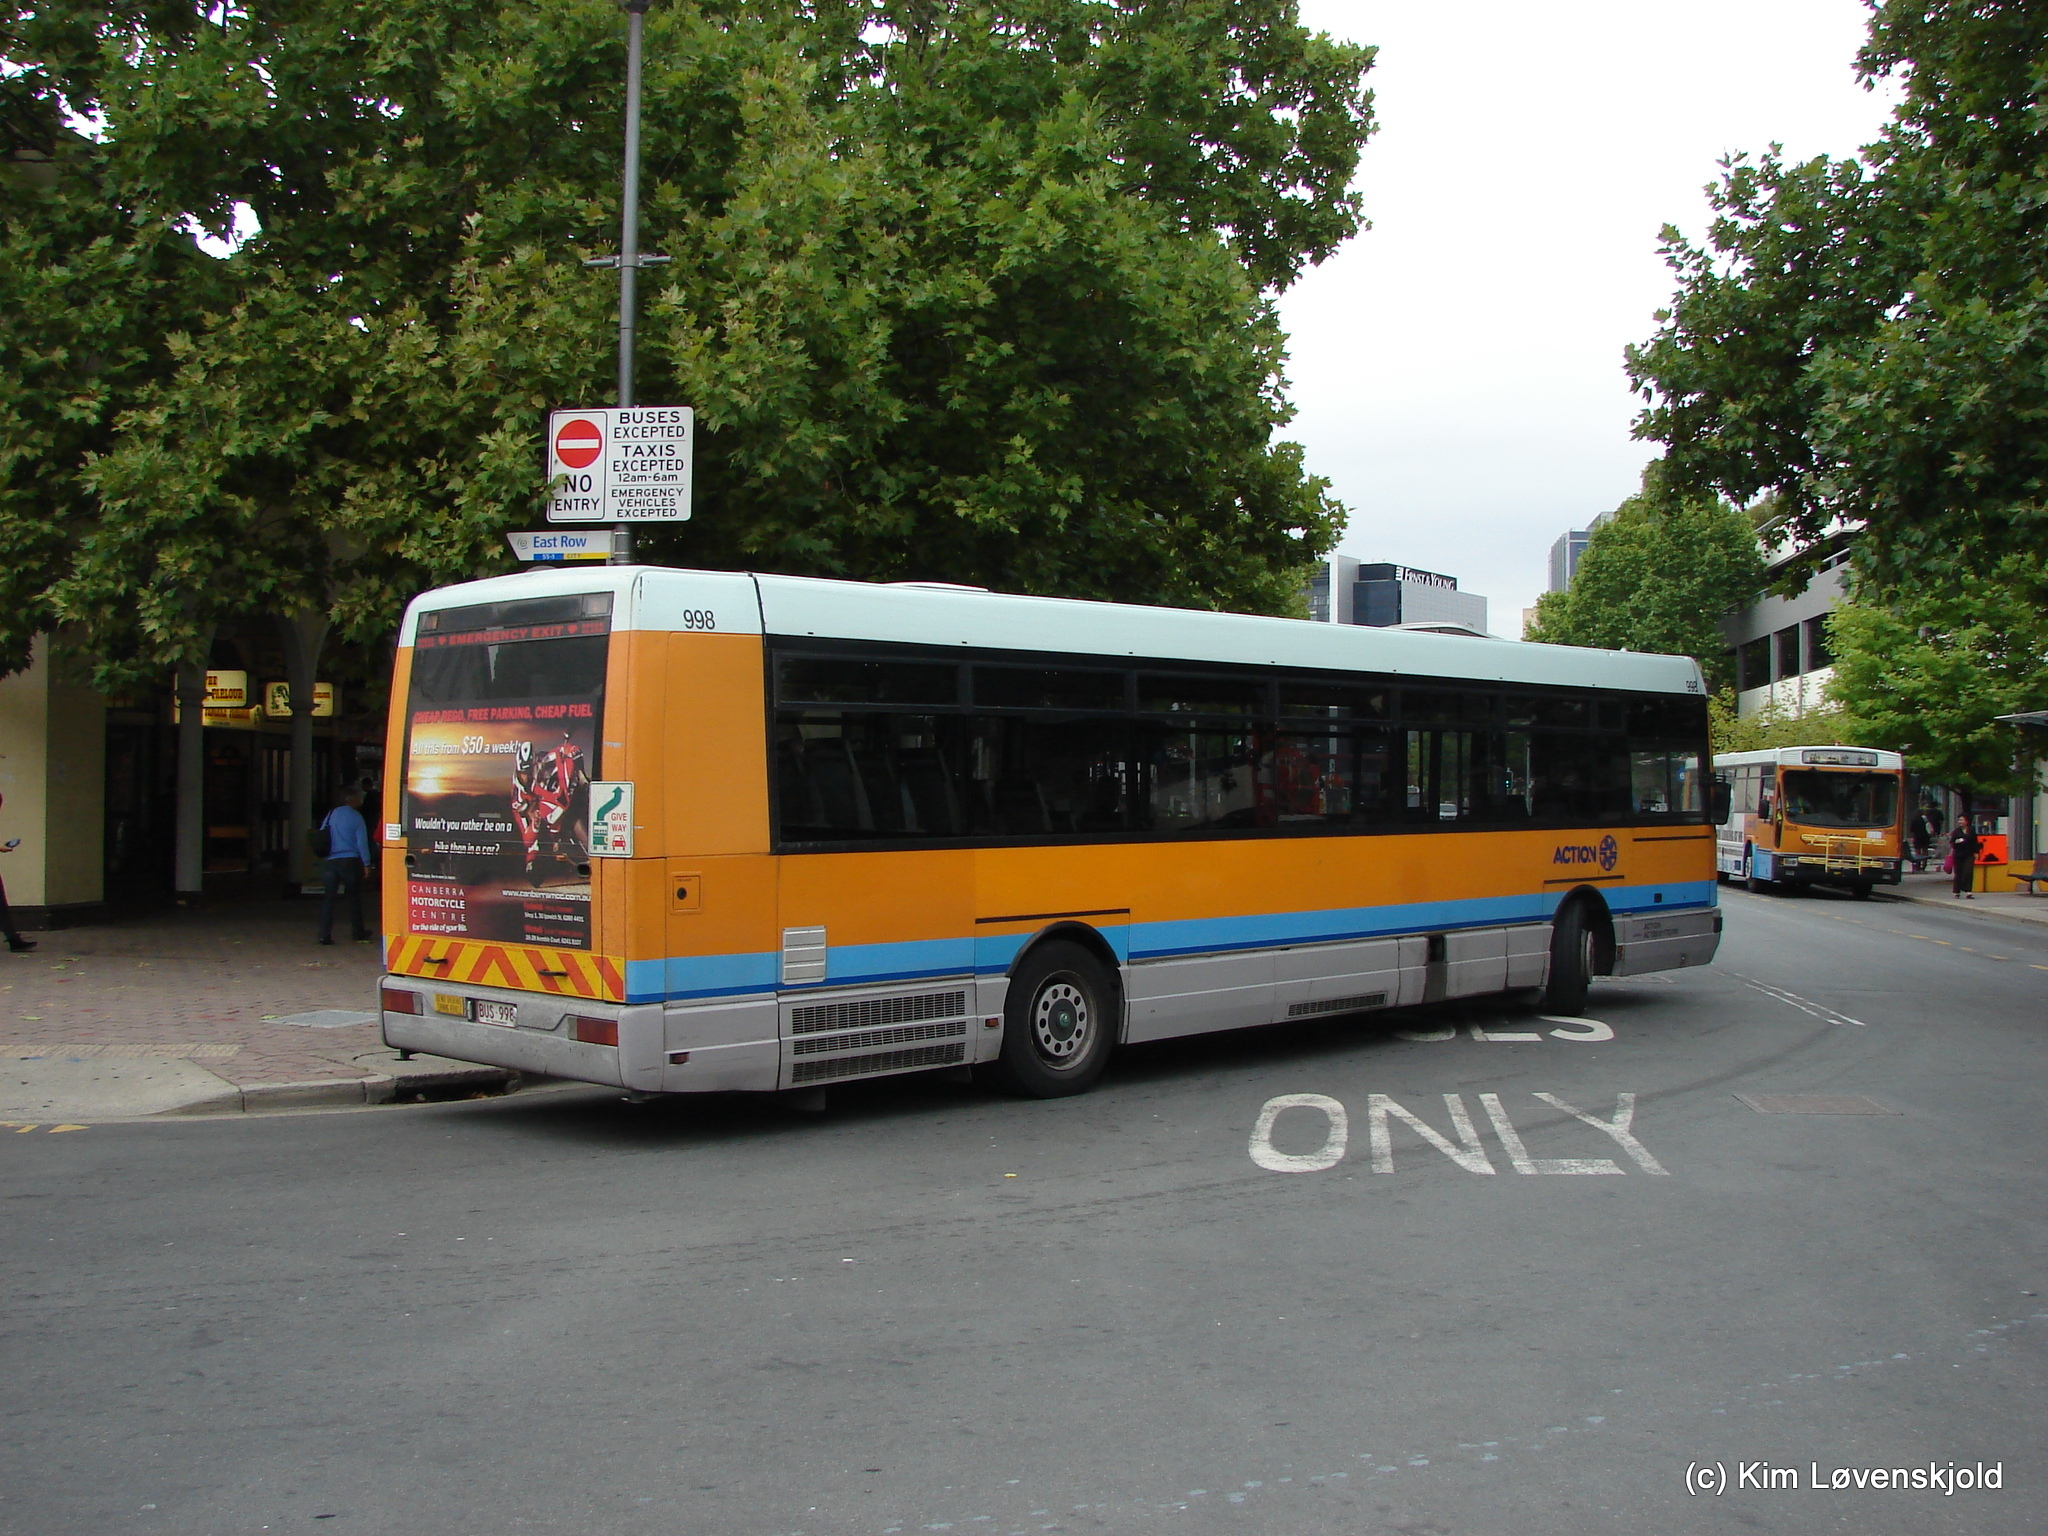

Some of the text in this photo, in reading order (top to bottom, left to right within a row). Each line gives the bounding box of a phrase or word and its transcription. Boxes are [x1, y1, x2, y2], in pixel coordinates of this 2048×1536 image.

[619, 411, 680, 424] BUSES
[614, 426, 685, 438] EXCEPTED
[622, 445, 676, 457] TAXIS
[612, 460, 684, 472] EXCEPTED
[564, 474, 592, 493] NO
[618, 473, 678, 482] 12am-6am
[611, 488, 684, 498] EMERGENCY
[555, 498, 600, 511] ENTRY
[619, 498, 676, 507] VEHICLES
[617, 509, 677, 518] EXCEPTED
[533, 535, 587, 548] East Row
[683, 609, 716, 630] 998
[450, 627, 528, 645] EMERGENCY
[531, 625, 564, 638] EXIT
[468, 707, 490, 721] FREE
[490, 706, 533, 721] PARKING,
[535, 704, 567, 719] CHEAP
[568, 703, 593, 717] FUEL
[425, 742, 440, 755] this
[440, 741, 460, 755] from
[461, 735, 484, 756] $50
[484, 744, 490, 753] a
[611, 812, 628, 821] GIVE
[415, 817, 513, 833] Wouldn't you rather be on a
[611, 823, 627, 832] WAY
[450, 841, 466, 855] than
[1553, 845, 1597, 864] ACTION
[411, 884, 465, 897] CANBERRA
[411, 896, 466, 910] MOTORCYCLE
[411, 910, 466, 922] CENTRE
[1248, 1092, 1671, 1176] ONLY
